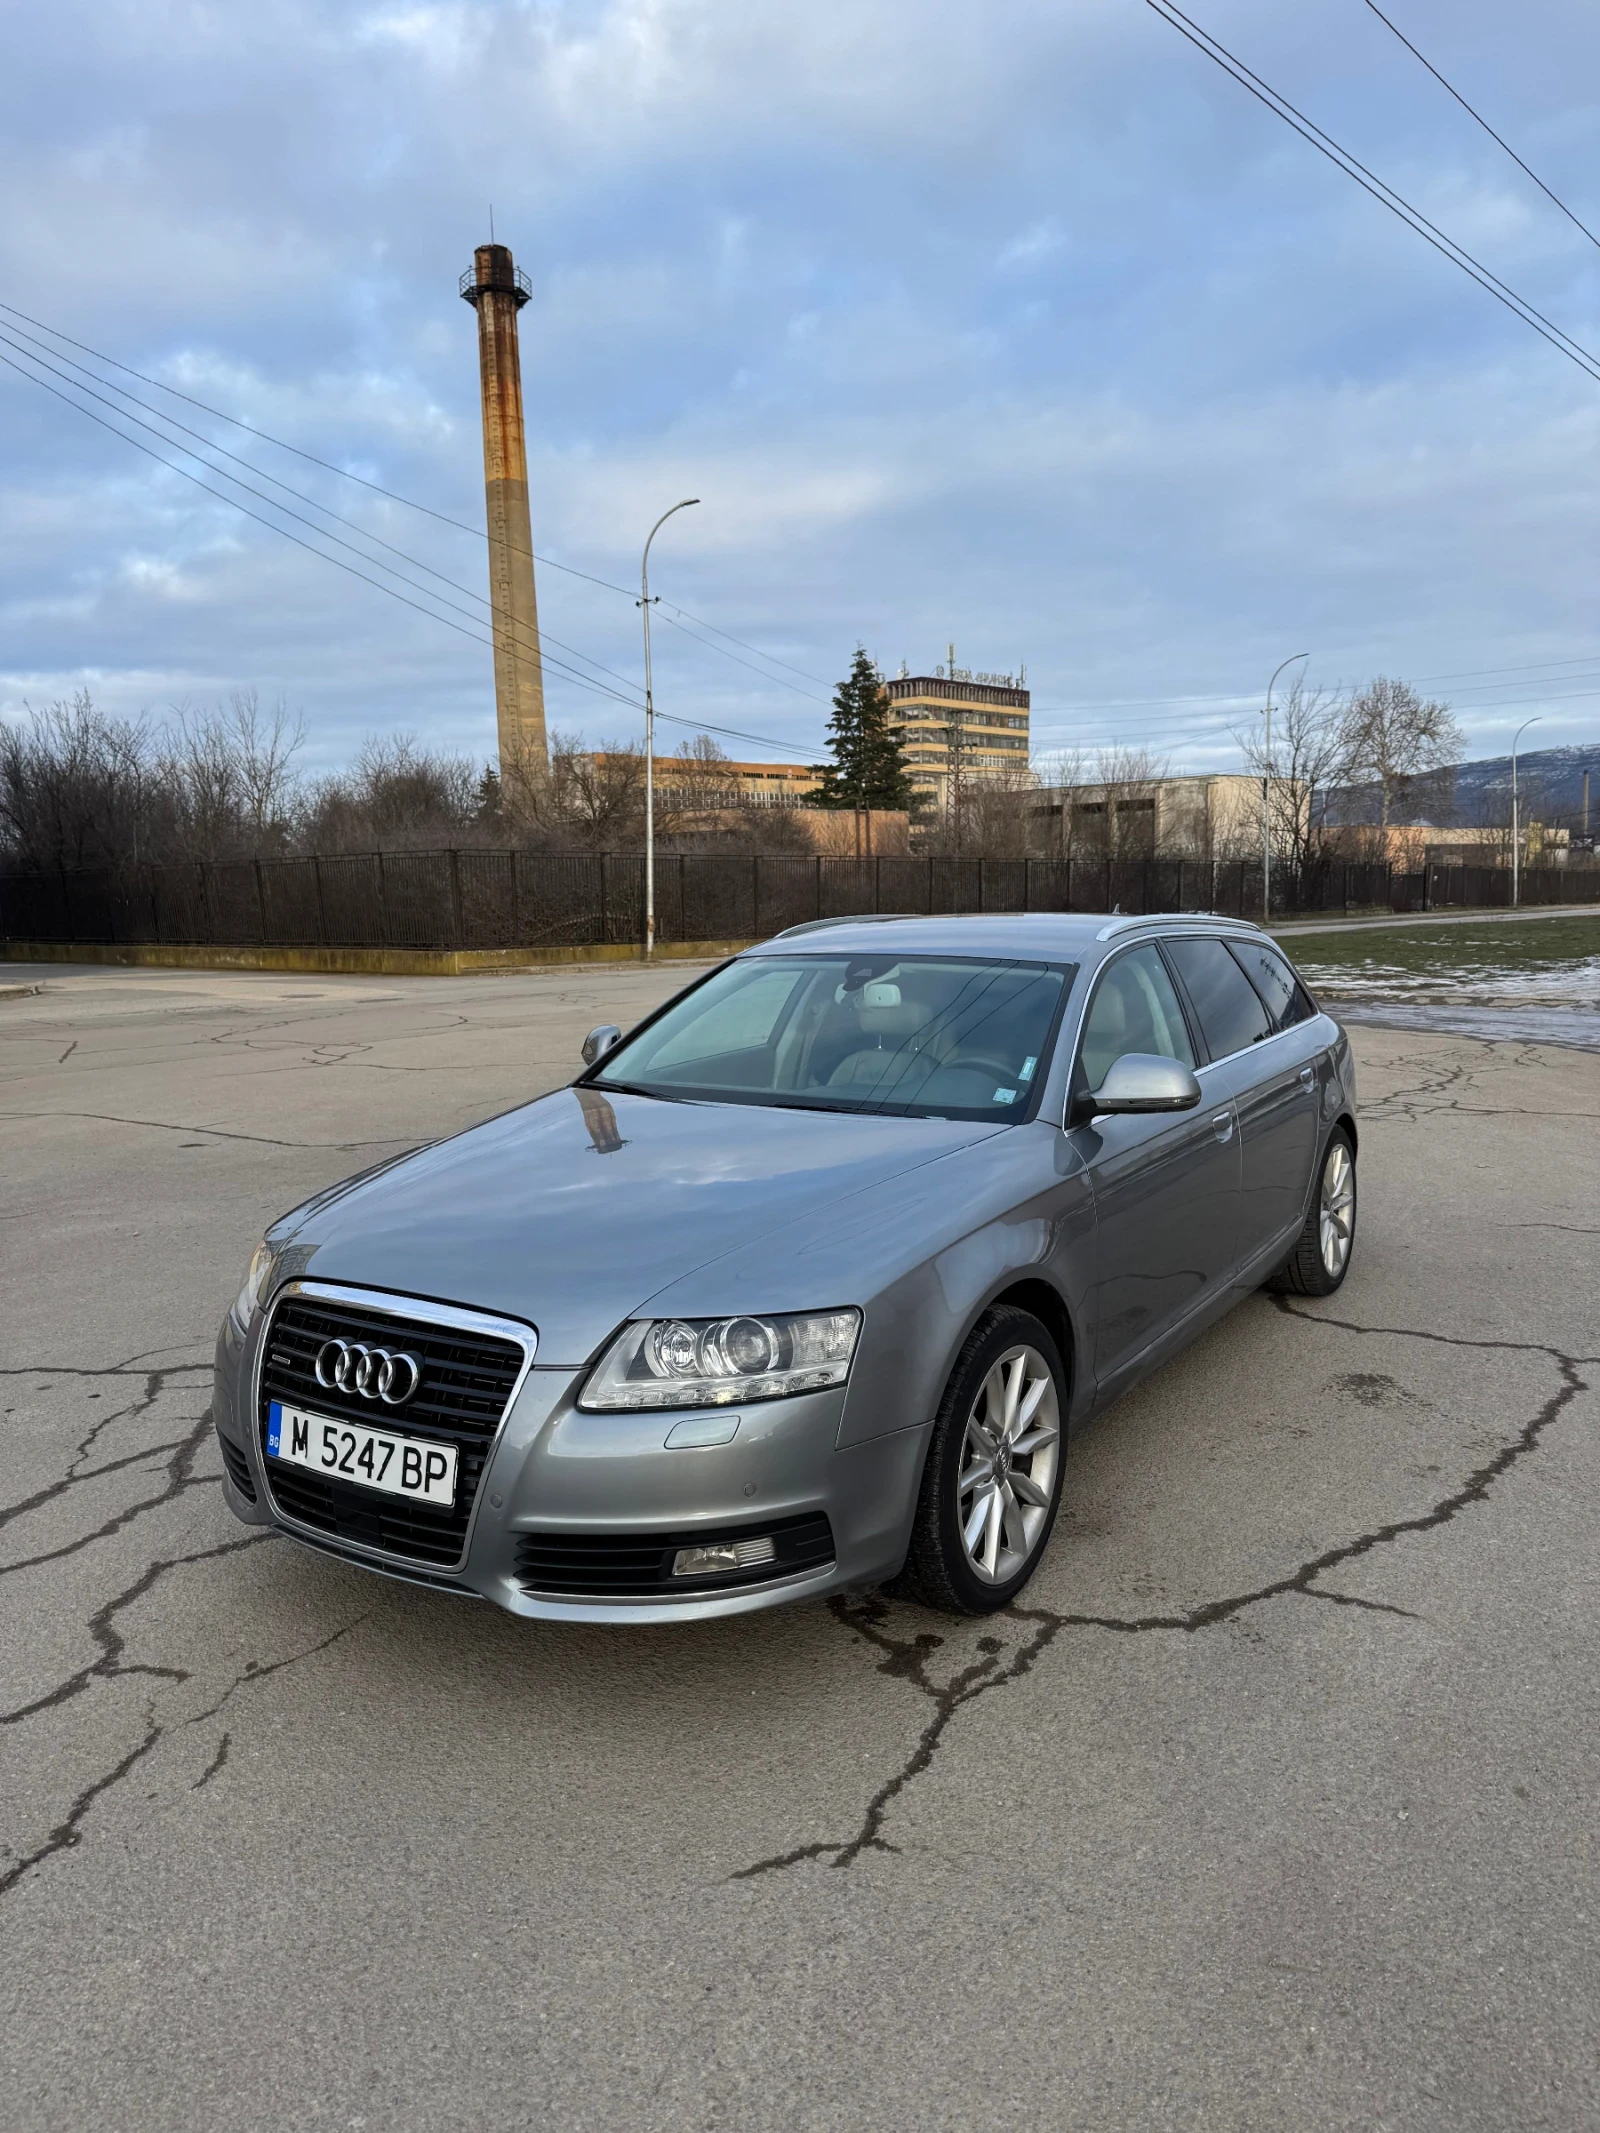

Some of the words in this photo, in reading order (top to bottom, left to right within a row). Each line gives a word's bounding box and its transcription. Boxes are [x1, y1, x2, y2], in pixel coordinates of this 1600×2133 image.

[269, 1435, 280, 1449] BG
[291, 1416, 309, 1459] M
[321, 1425, 396, 1482] 5247
[401, 1445, 448, 1493] BP
